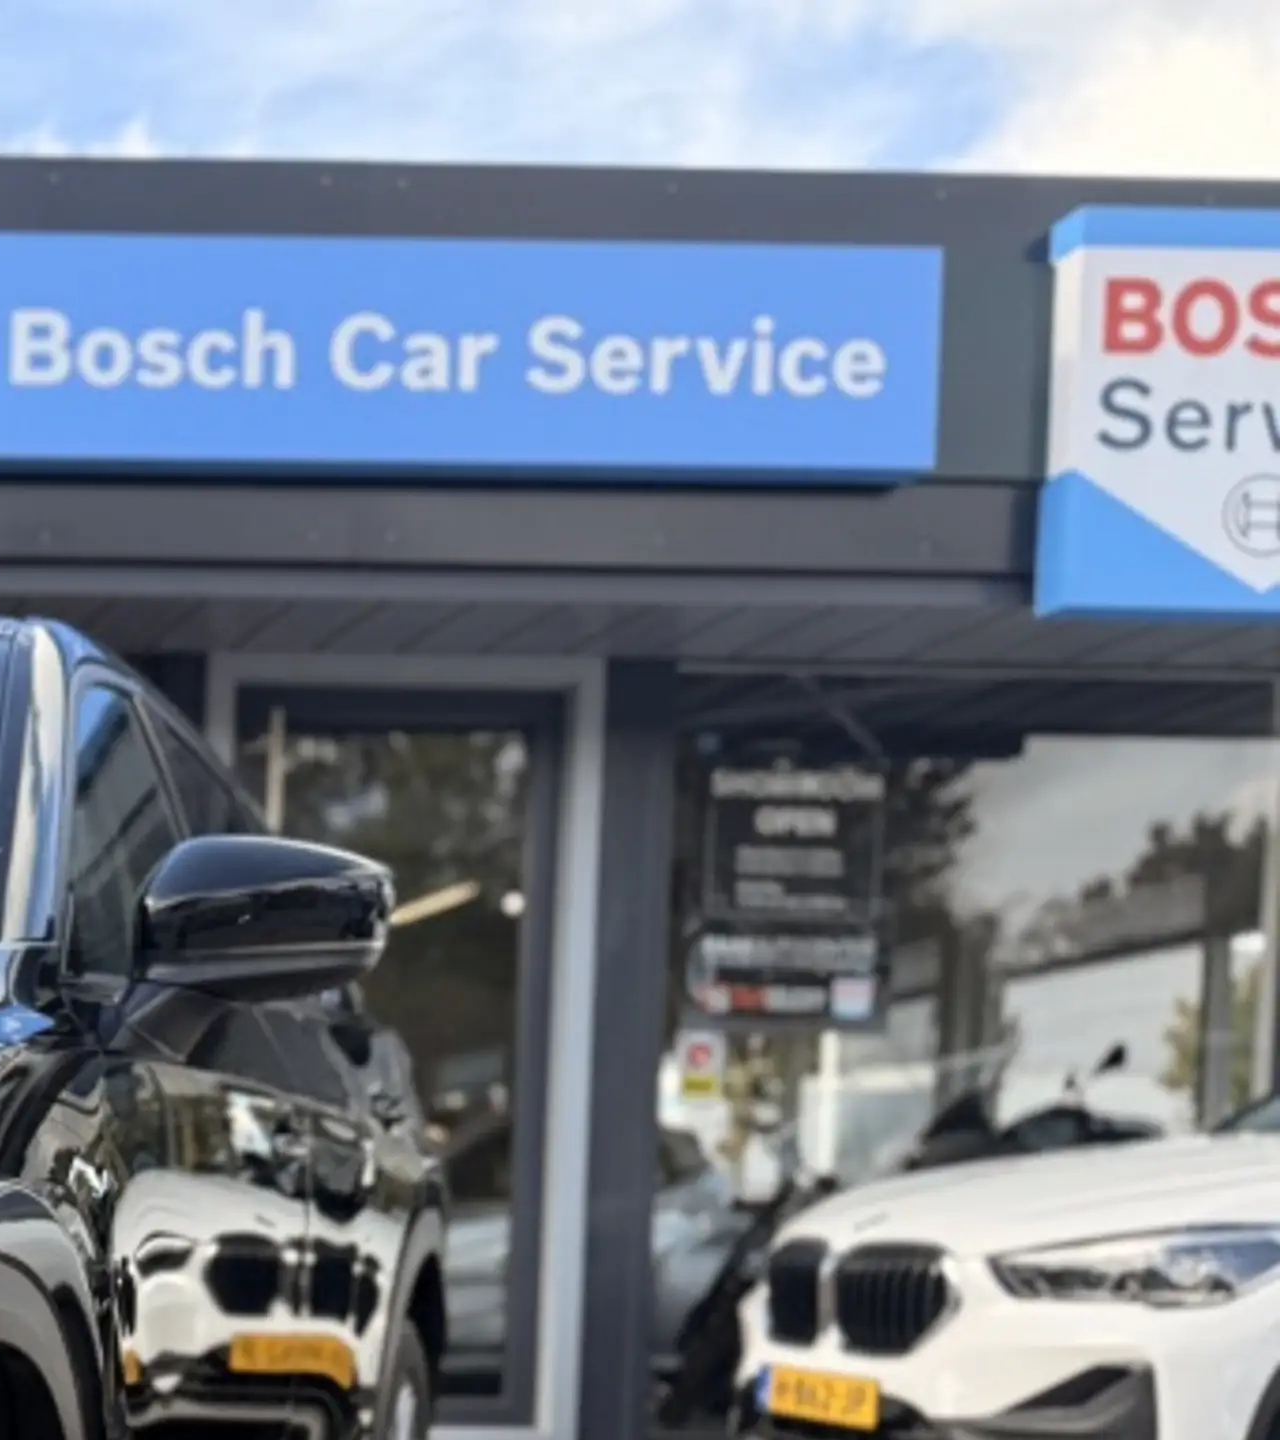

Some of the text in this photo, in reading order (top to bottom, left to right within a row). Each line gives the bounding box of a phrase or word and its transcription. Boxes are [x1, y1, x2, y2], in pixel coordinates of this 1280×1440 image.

[9, 308, 886, 398] Bosch Car Service
